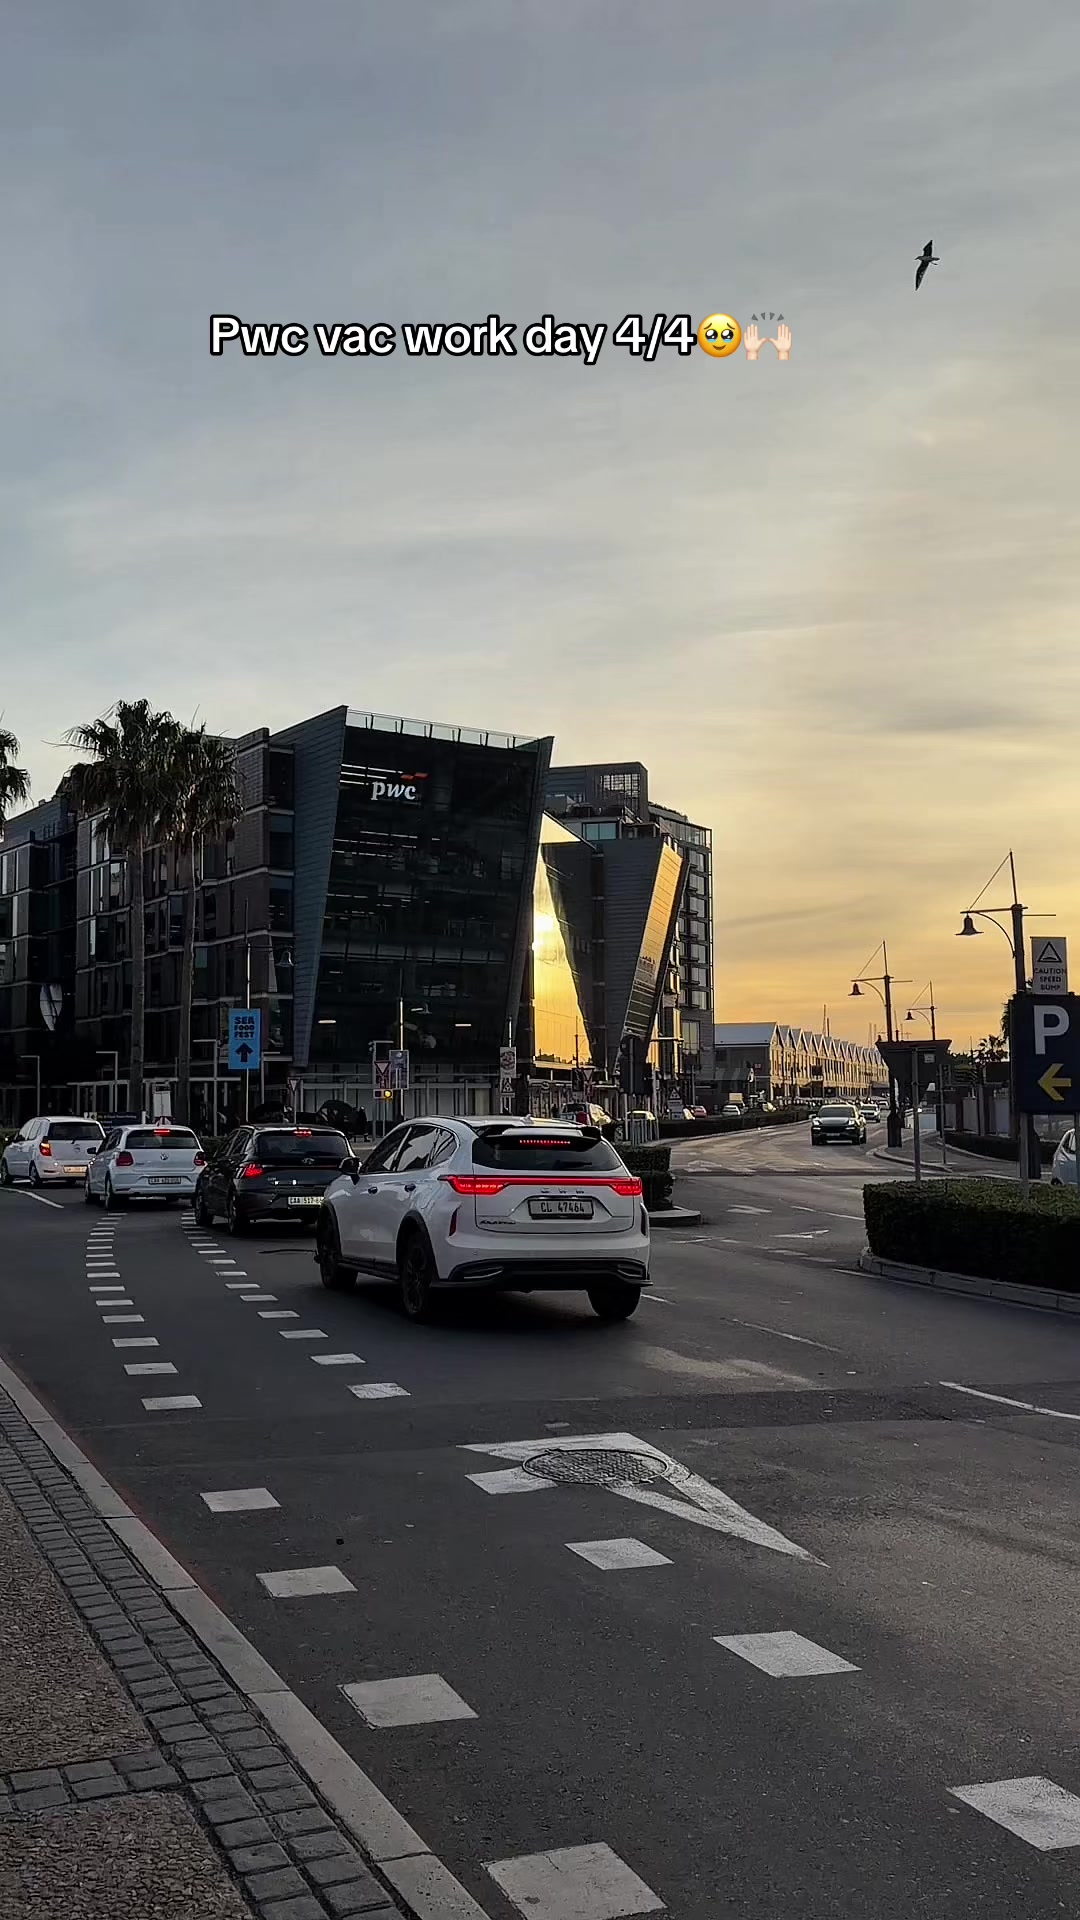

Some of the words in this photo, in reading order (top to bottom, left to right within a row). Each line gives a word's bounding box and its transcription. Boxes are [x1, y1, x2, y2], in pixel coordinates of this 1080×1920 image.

[370, 780, 416, 800] pwc
[1034, 967, 1064, 975] CAUTION
[1040, 975, 1061, 983] SPEED
[234, 1016, 254, 1025] SEA
[1034, 1005, 1069, 1054] P
[540, 1202, 552, 1213] CL
